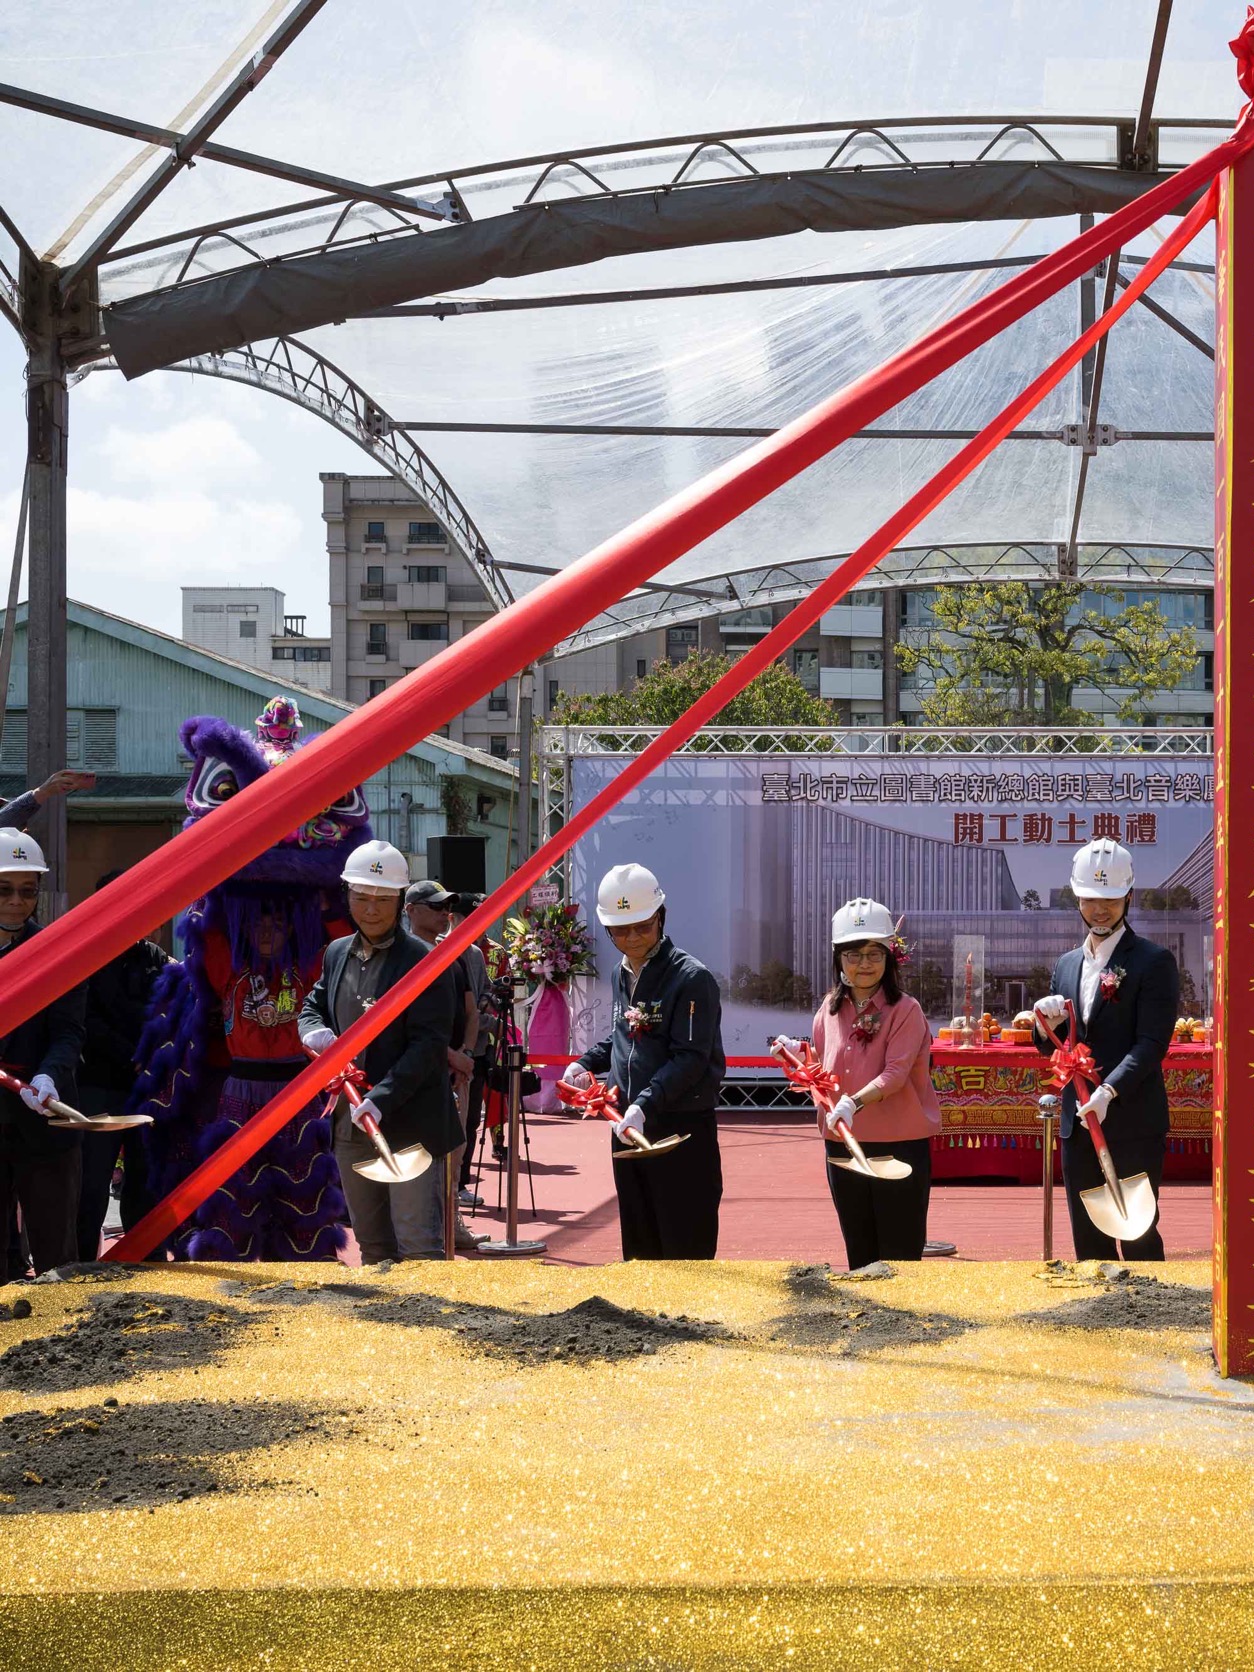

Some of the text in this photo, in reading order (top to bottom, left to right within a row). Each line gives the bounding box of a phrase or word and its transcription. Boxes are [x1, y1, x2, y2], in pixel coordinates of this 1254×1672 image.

[953, 812, 1157, 845] 開工動土典禮
